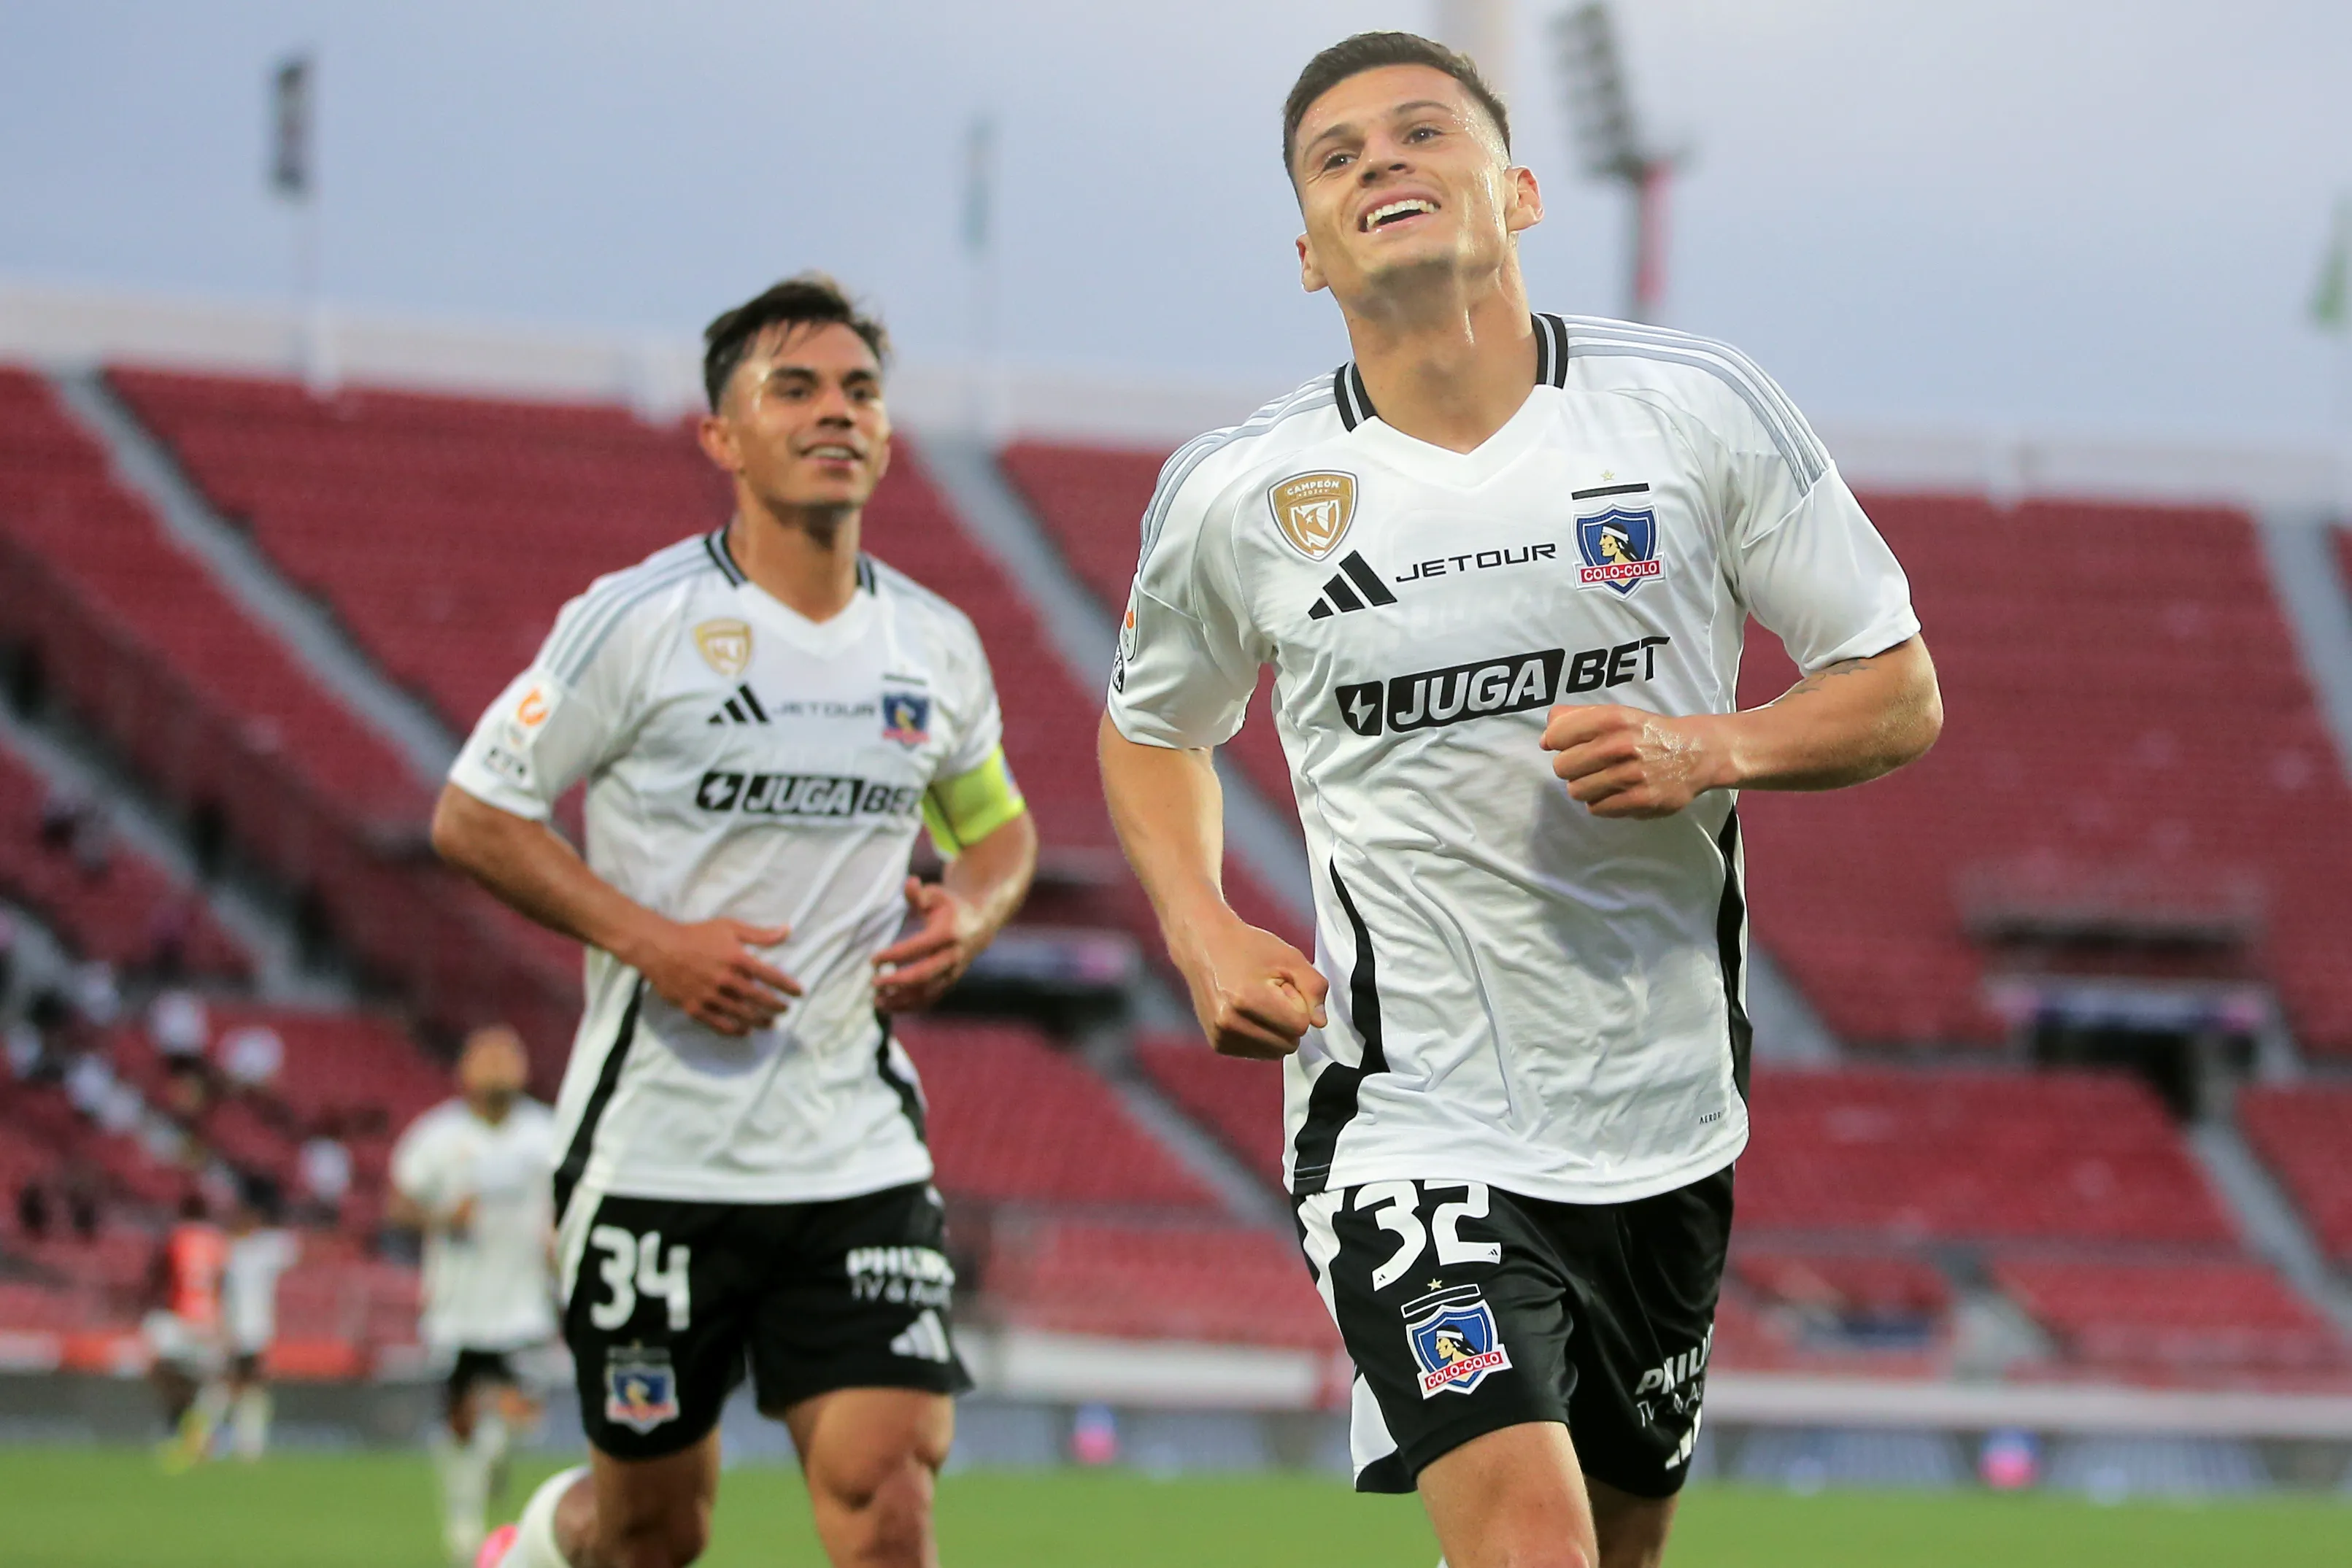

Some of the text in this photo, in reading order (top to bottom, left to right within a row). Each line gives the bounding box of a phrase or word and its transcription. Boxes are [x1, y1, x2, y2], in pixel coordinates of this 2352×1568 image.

[1287, 479, 1340, 495] CAMPEÓN
[1396, 544, 1556, 582] JETOUR
[1584, 563, 1657, 581] COLO-COLO
[1395, 636, 1670, 726] JUGA BET
[1354, 1180, 1501, 1291] 32
[590, 1224, 691, 1330] 34
[1427, 1353, 1499, 1388] COLO-COLO
